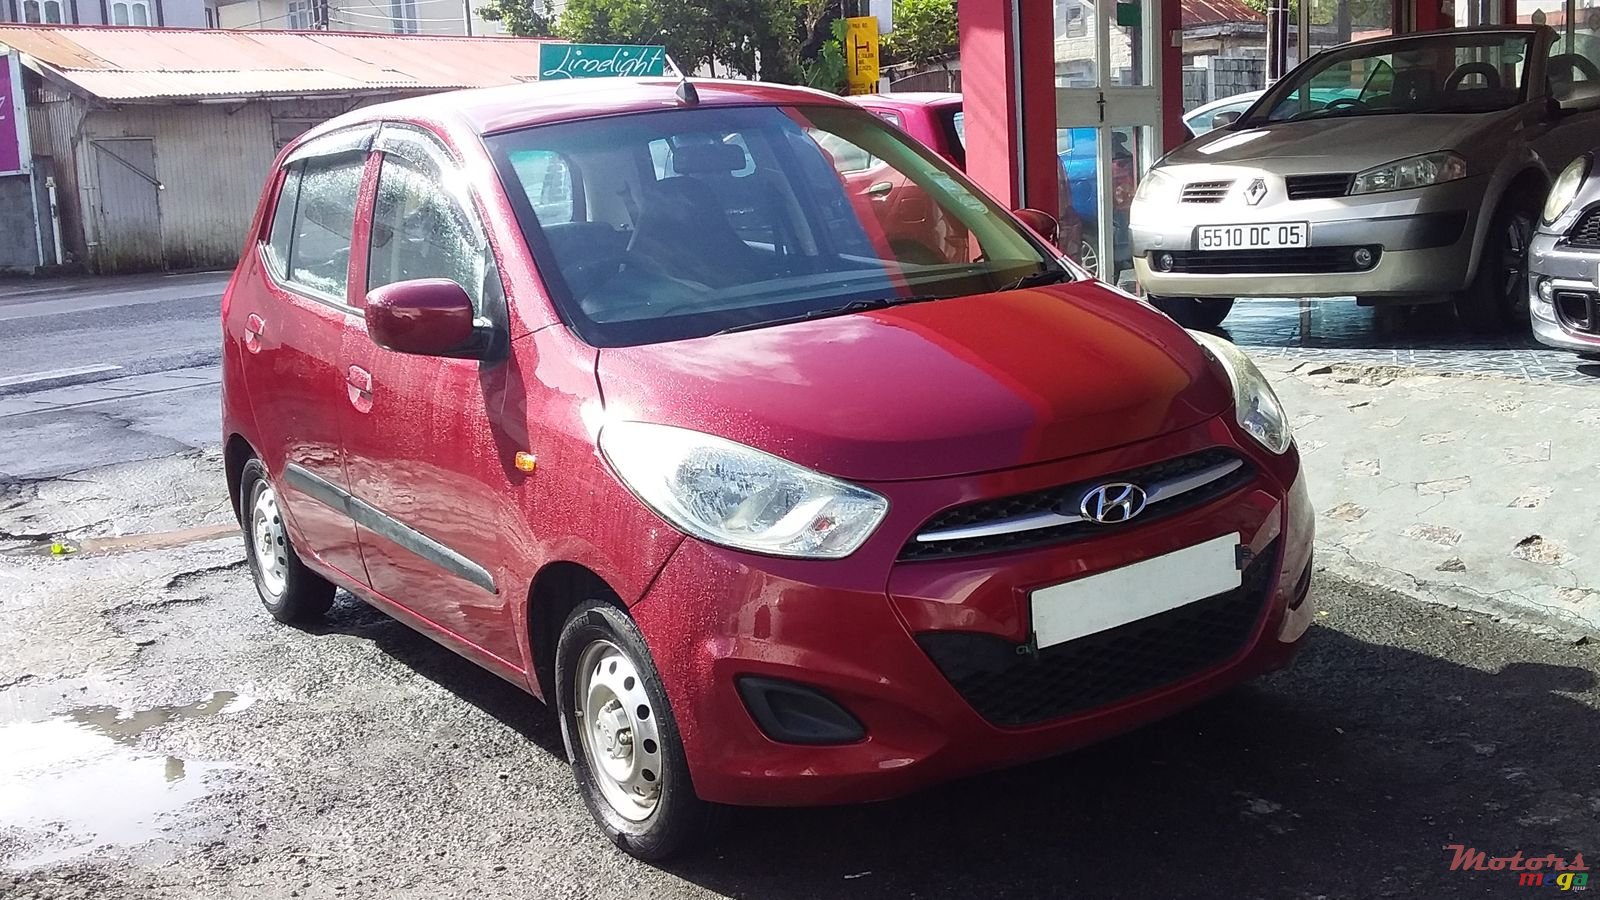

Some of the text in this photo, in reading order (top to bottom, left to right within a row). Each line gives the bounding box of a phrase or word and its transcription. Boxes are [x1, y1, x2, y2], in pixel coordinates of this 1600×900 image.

[543, 46, 661, 79] Limelight
[1203, 226, 1300, 247] 5510 DC 05
